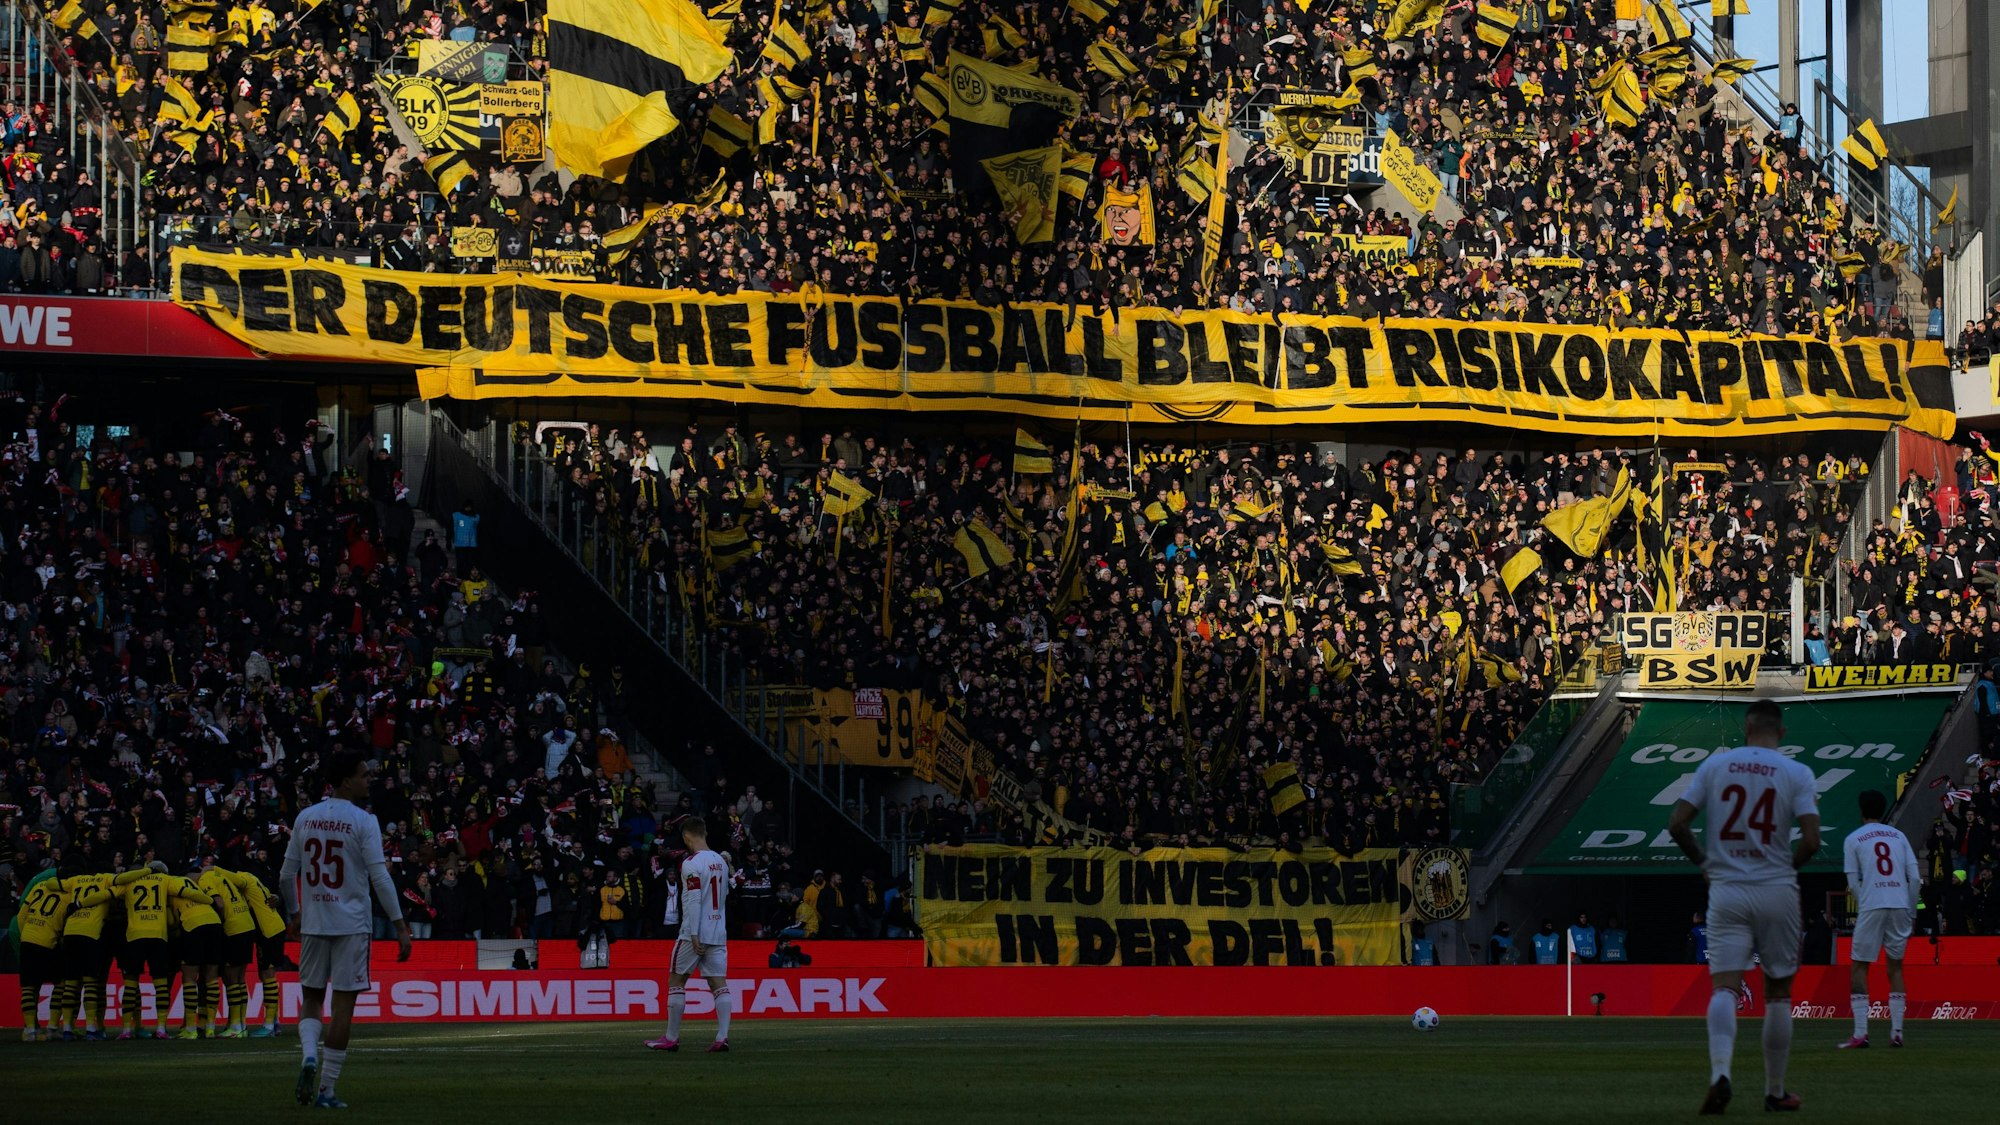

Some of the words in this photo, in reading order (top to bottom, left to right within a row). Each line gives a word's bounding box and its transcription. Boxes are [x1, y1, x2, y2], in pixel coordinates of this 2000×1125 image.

[454, 62, 477, 80] 1991
[957, 70, 982, 95] BVB
[396, 98, 436, 114] BLK
[483, 97, 540, 110] Bollerberg
[499, 258, 531, 268] ALEKS
[180, 263, 350, 336] DER
[362, 278, 755, 367] DEUTSCHE
[766, 300, 1122, 383] FUSSBALL
[1136, 319, 1374, 389] BLEIBT
[1387, 328, 1908, 404] RISIKOKAPITAL!
[1626, 615, 1672, 649] SG
[1715, 615, 1764, 649] RB
[1648, 654, 1756, 686] BSW
[1813, 663, 1952, 687] WEIMAR
[1631, 743, 1806, 764] Coe
[1813, 742, 1906, 762] on,
[1728, 762, 1777, 778] CHABOT
[1719, 783, 1777, 845] 24
[304, 837, 344, 889] 35
[1874, 841, 1893, 876] 8
[923, 854, 1032, 902] NEIN
[1045, 856, 1104, 905] ZU
[1119, 859, 1399, 907] INVESTOREN
[27, 889, 61, 917] 20
[133, 884, 161, 911] 21
[995, 914, 1059, 965] IN
[1076, 917, 1194, 967] DER
[1208, 918, 1336, 967] DFL!
[391, 979, 660, 1017] SIMMER
[683, 977, 889, 1016] STARK
[1791, 1001, 1836, 1019] DERTOUR
[1932, 1002, 1977, 1020] DERTOUR
